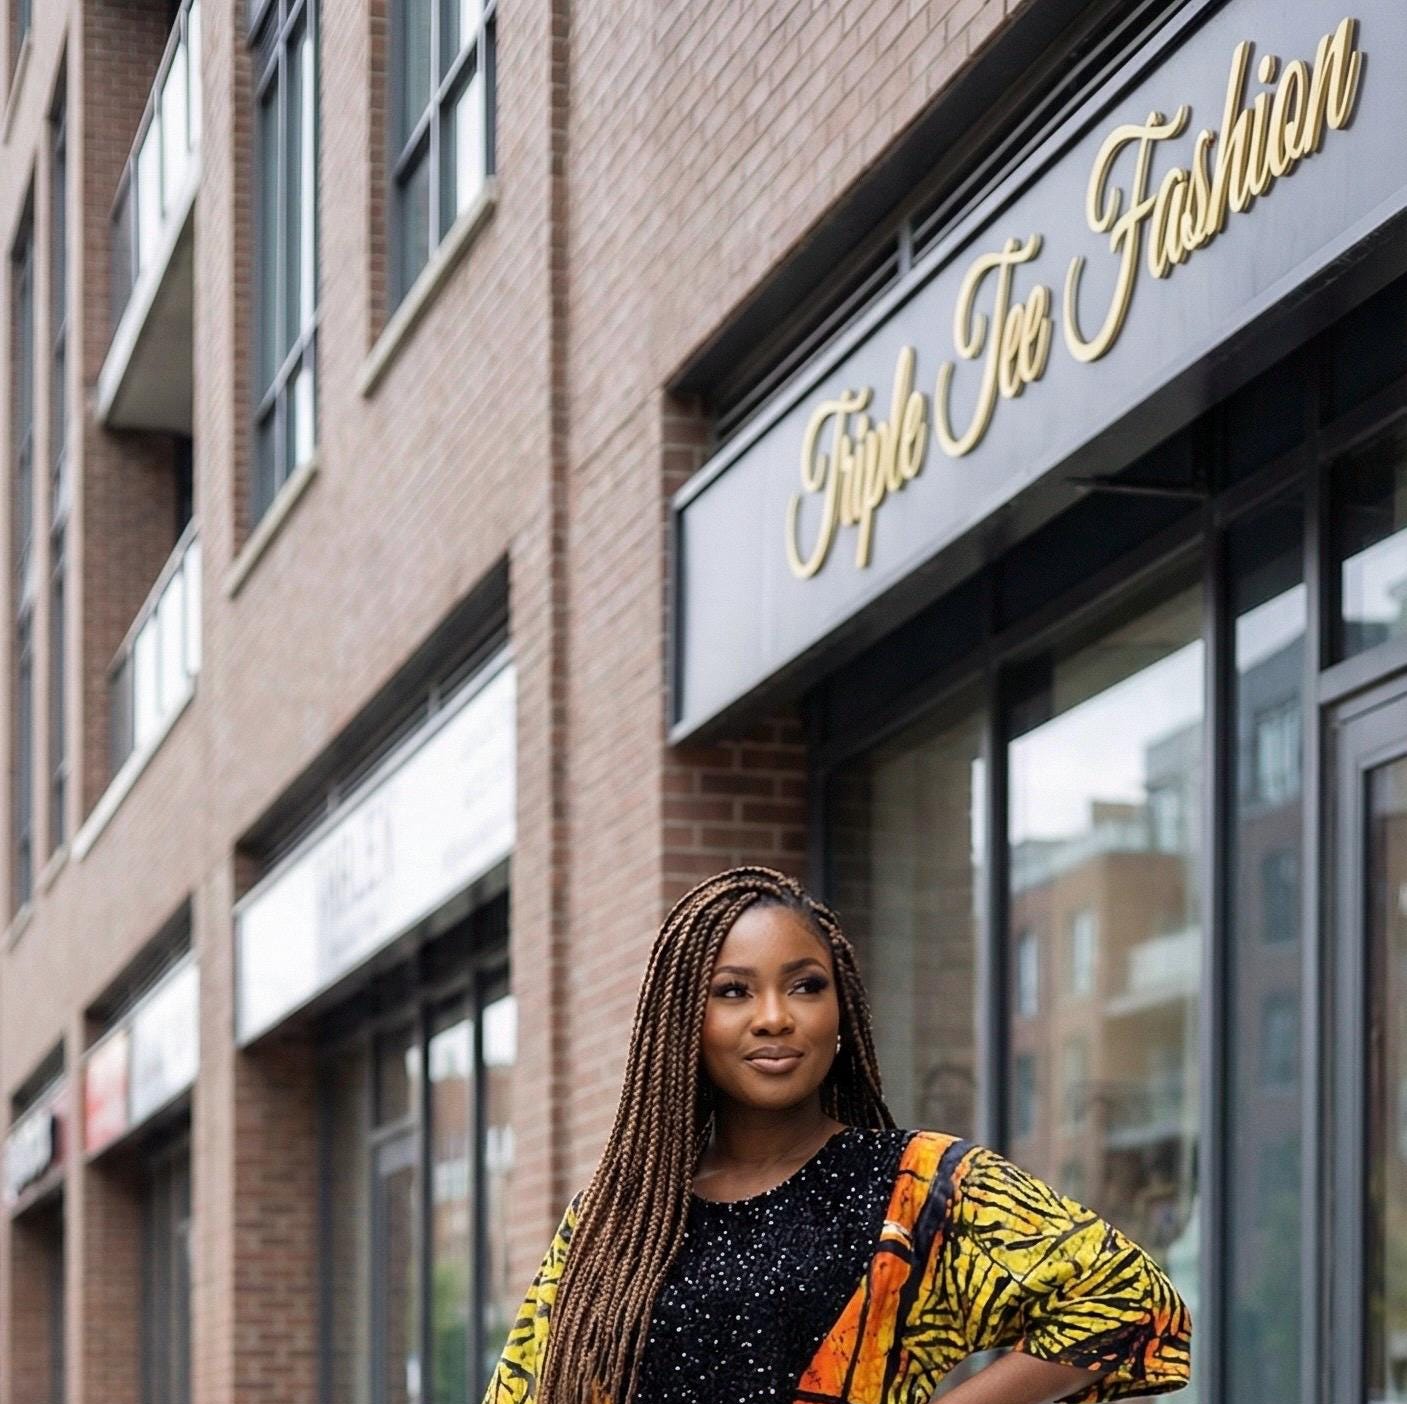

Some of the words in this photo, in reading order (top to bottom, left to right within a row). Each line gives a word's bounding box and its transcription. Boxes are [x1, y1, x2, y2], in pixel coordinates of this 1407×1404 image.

[786, 345, 927, 579] Triple
[935, 232, 1052, 457] Tee
[1063, 17, 1364, 361] Fashion
